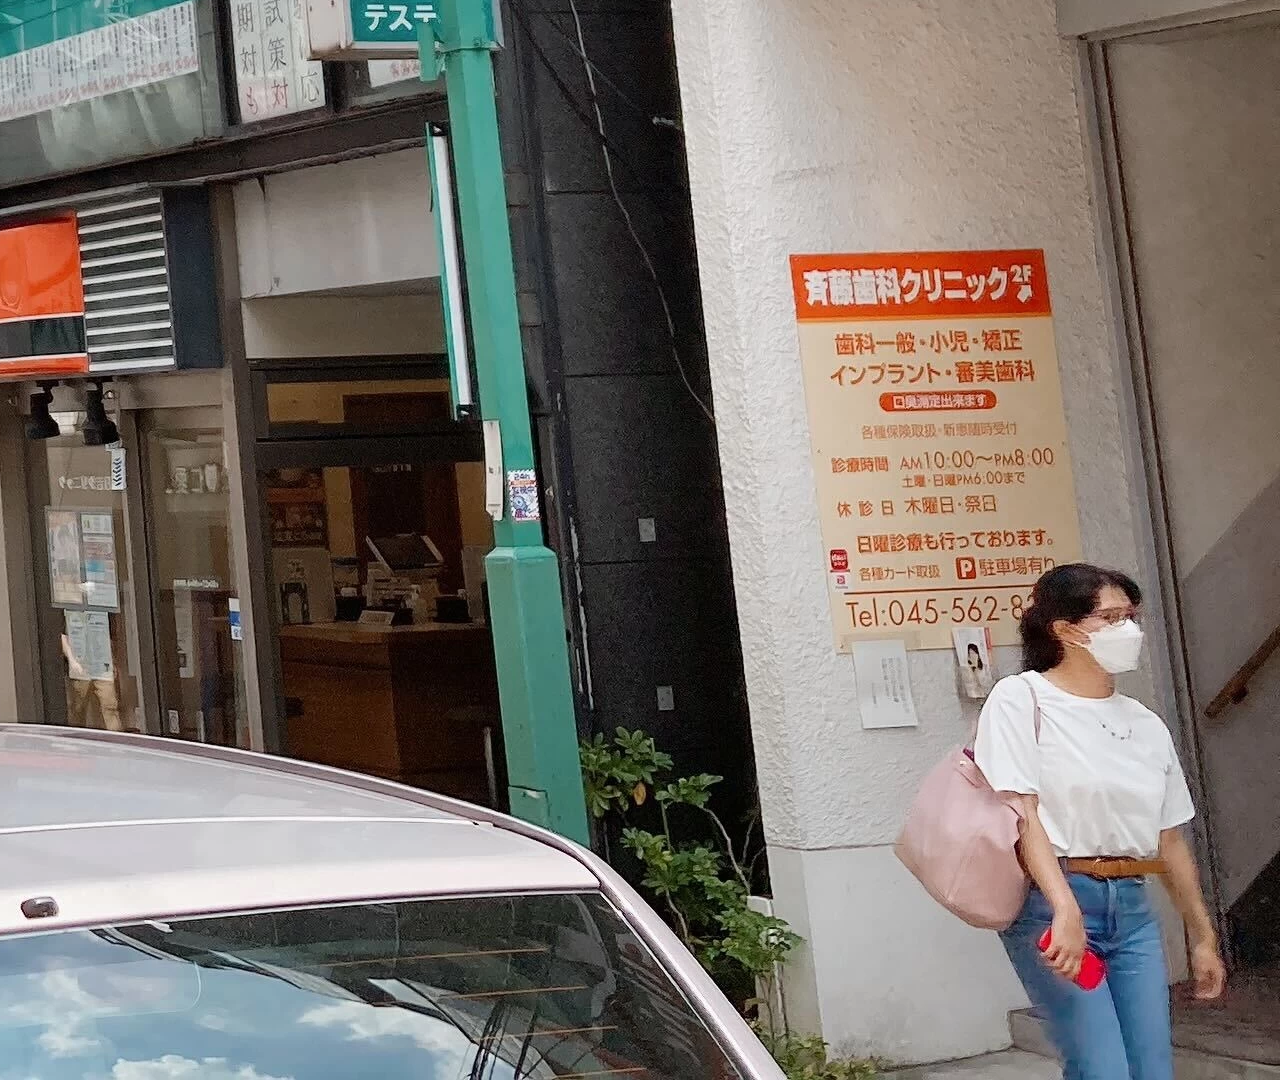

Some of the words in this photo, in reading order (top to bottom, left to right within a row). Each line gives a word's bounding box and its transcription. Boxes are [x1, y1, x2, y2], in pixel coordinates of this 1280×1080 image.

[834, 329, 1023, 356] 歯科一般・小児・矯正
[830, 359, 1035, 386] インプラント・審美歯科
[831, 455, 889, 473] 診療時間
[904, 494, 998, 515] 木曜日・祭日
[856, 528, 1054, 554] 日曜診療も行っております。
[844, 595, 1040, 628] Tel:045-562-8
